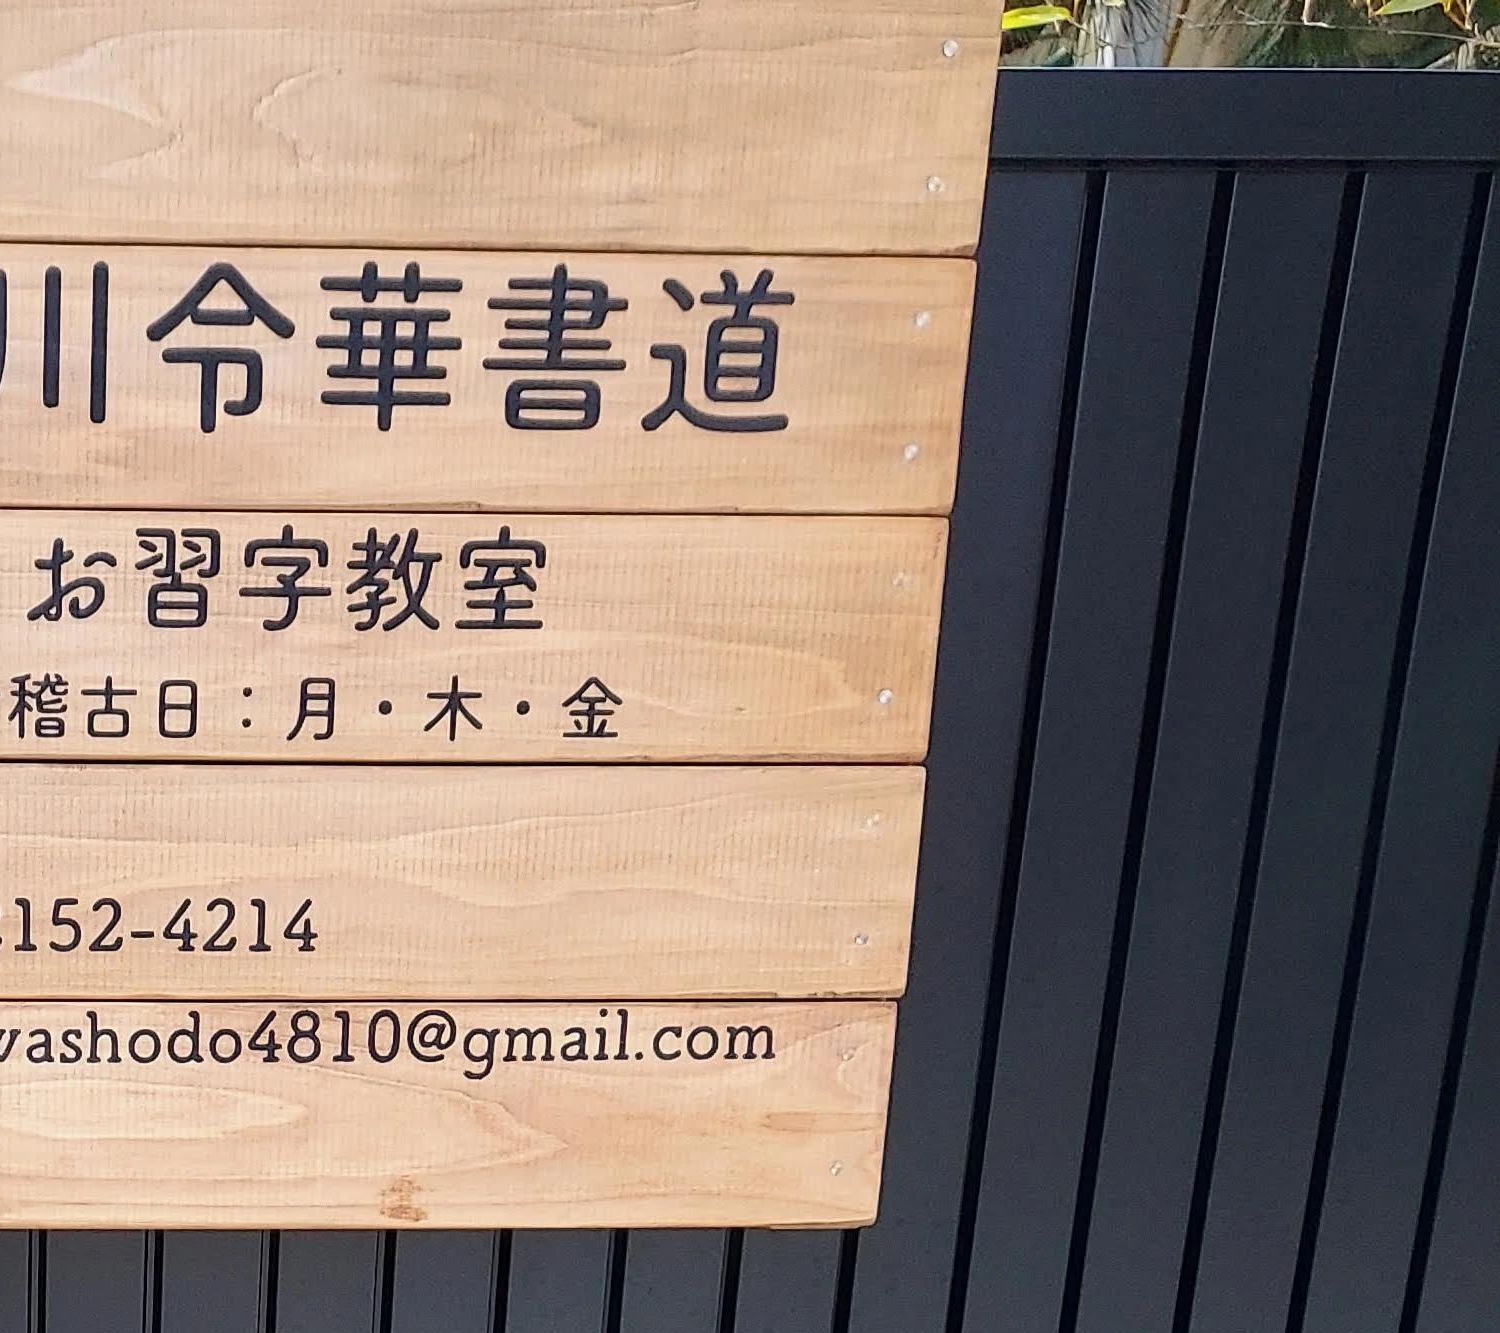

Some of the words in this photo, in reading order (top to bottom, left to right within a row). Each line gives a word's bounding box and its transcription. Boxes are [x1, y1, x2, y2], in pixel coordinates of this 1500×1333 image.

[25, 523, 549, 633] お習字教室
